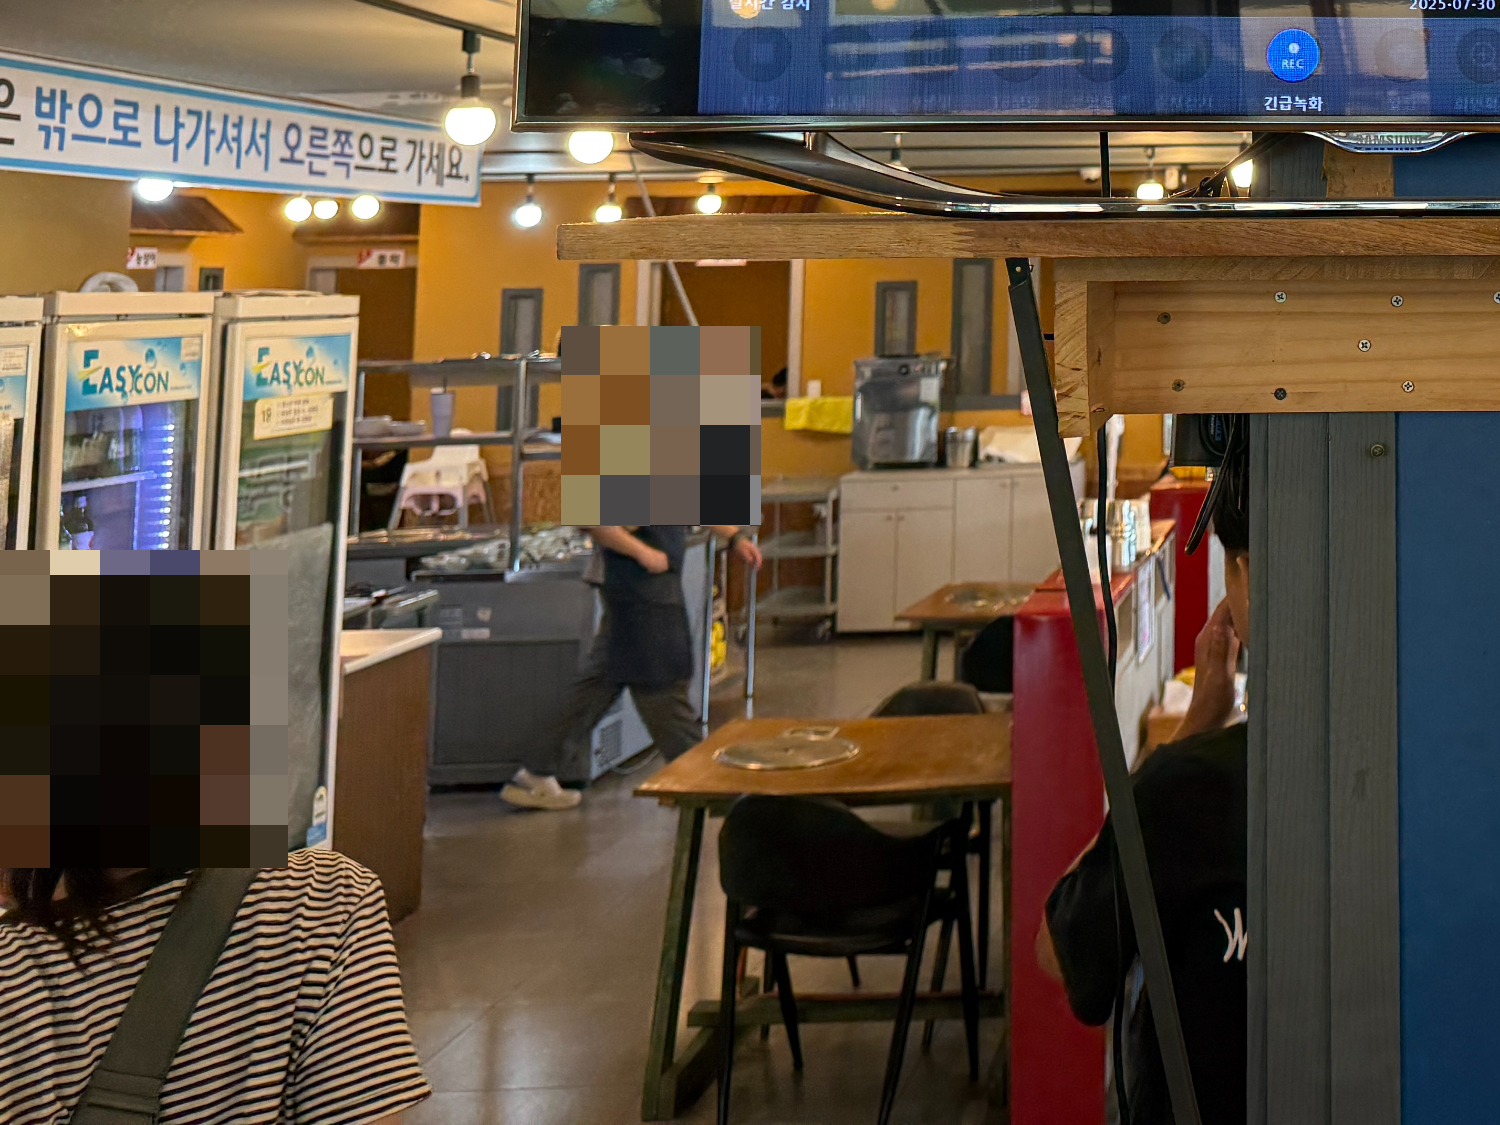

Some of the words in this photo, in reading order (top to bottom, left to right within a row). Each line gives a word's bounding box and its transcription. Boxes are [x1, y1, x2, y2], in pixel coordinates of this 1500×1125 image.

[1281, 58, 1304, 69] REC
[1264, 96, 1323, 112] 긴급녹화
[35, 86, 141, 152] 밖으로
[154, 104, 271, 172] 나가셔서
[280, 122, 399, 179] 오른쪽으로
